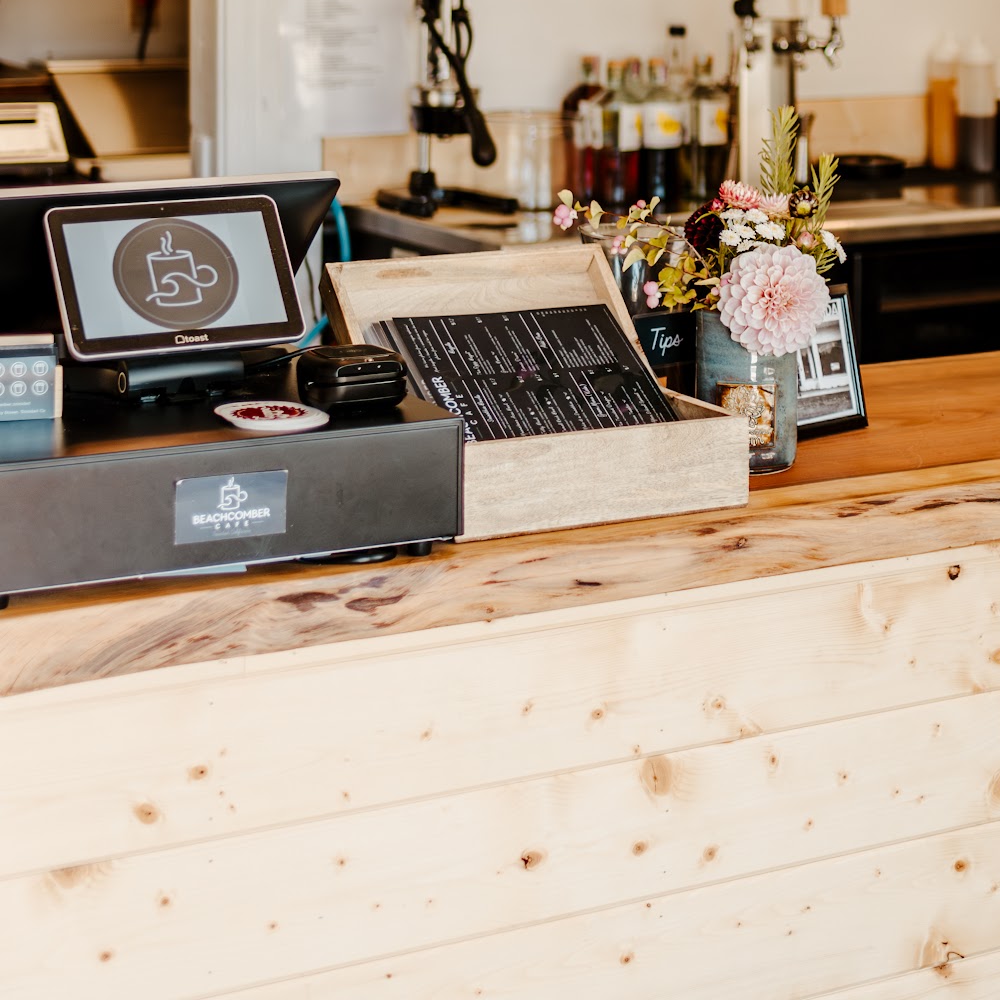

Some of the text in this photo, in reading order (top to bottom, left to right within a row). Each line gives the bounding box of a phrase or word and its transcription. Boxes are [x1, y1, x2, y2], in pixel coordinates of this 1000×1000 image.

[184, 333, 209, 343] toast
[650, 326, 684, 357] Tips
[192, 507, 271, 526] BEACHCOMBER
[214, 520, 250, 530] CAFE
